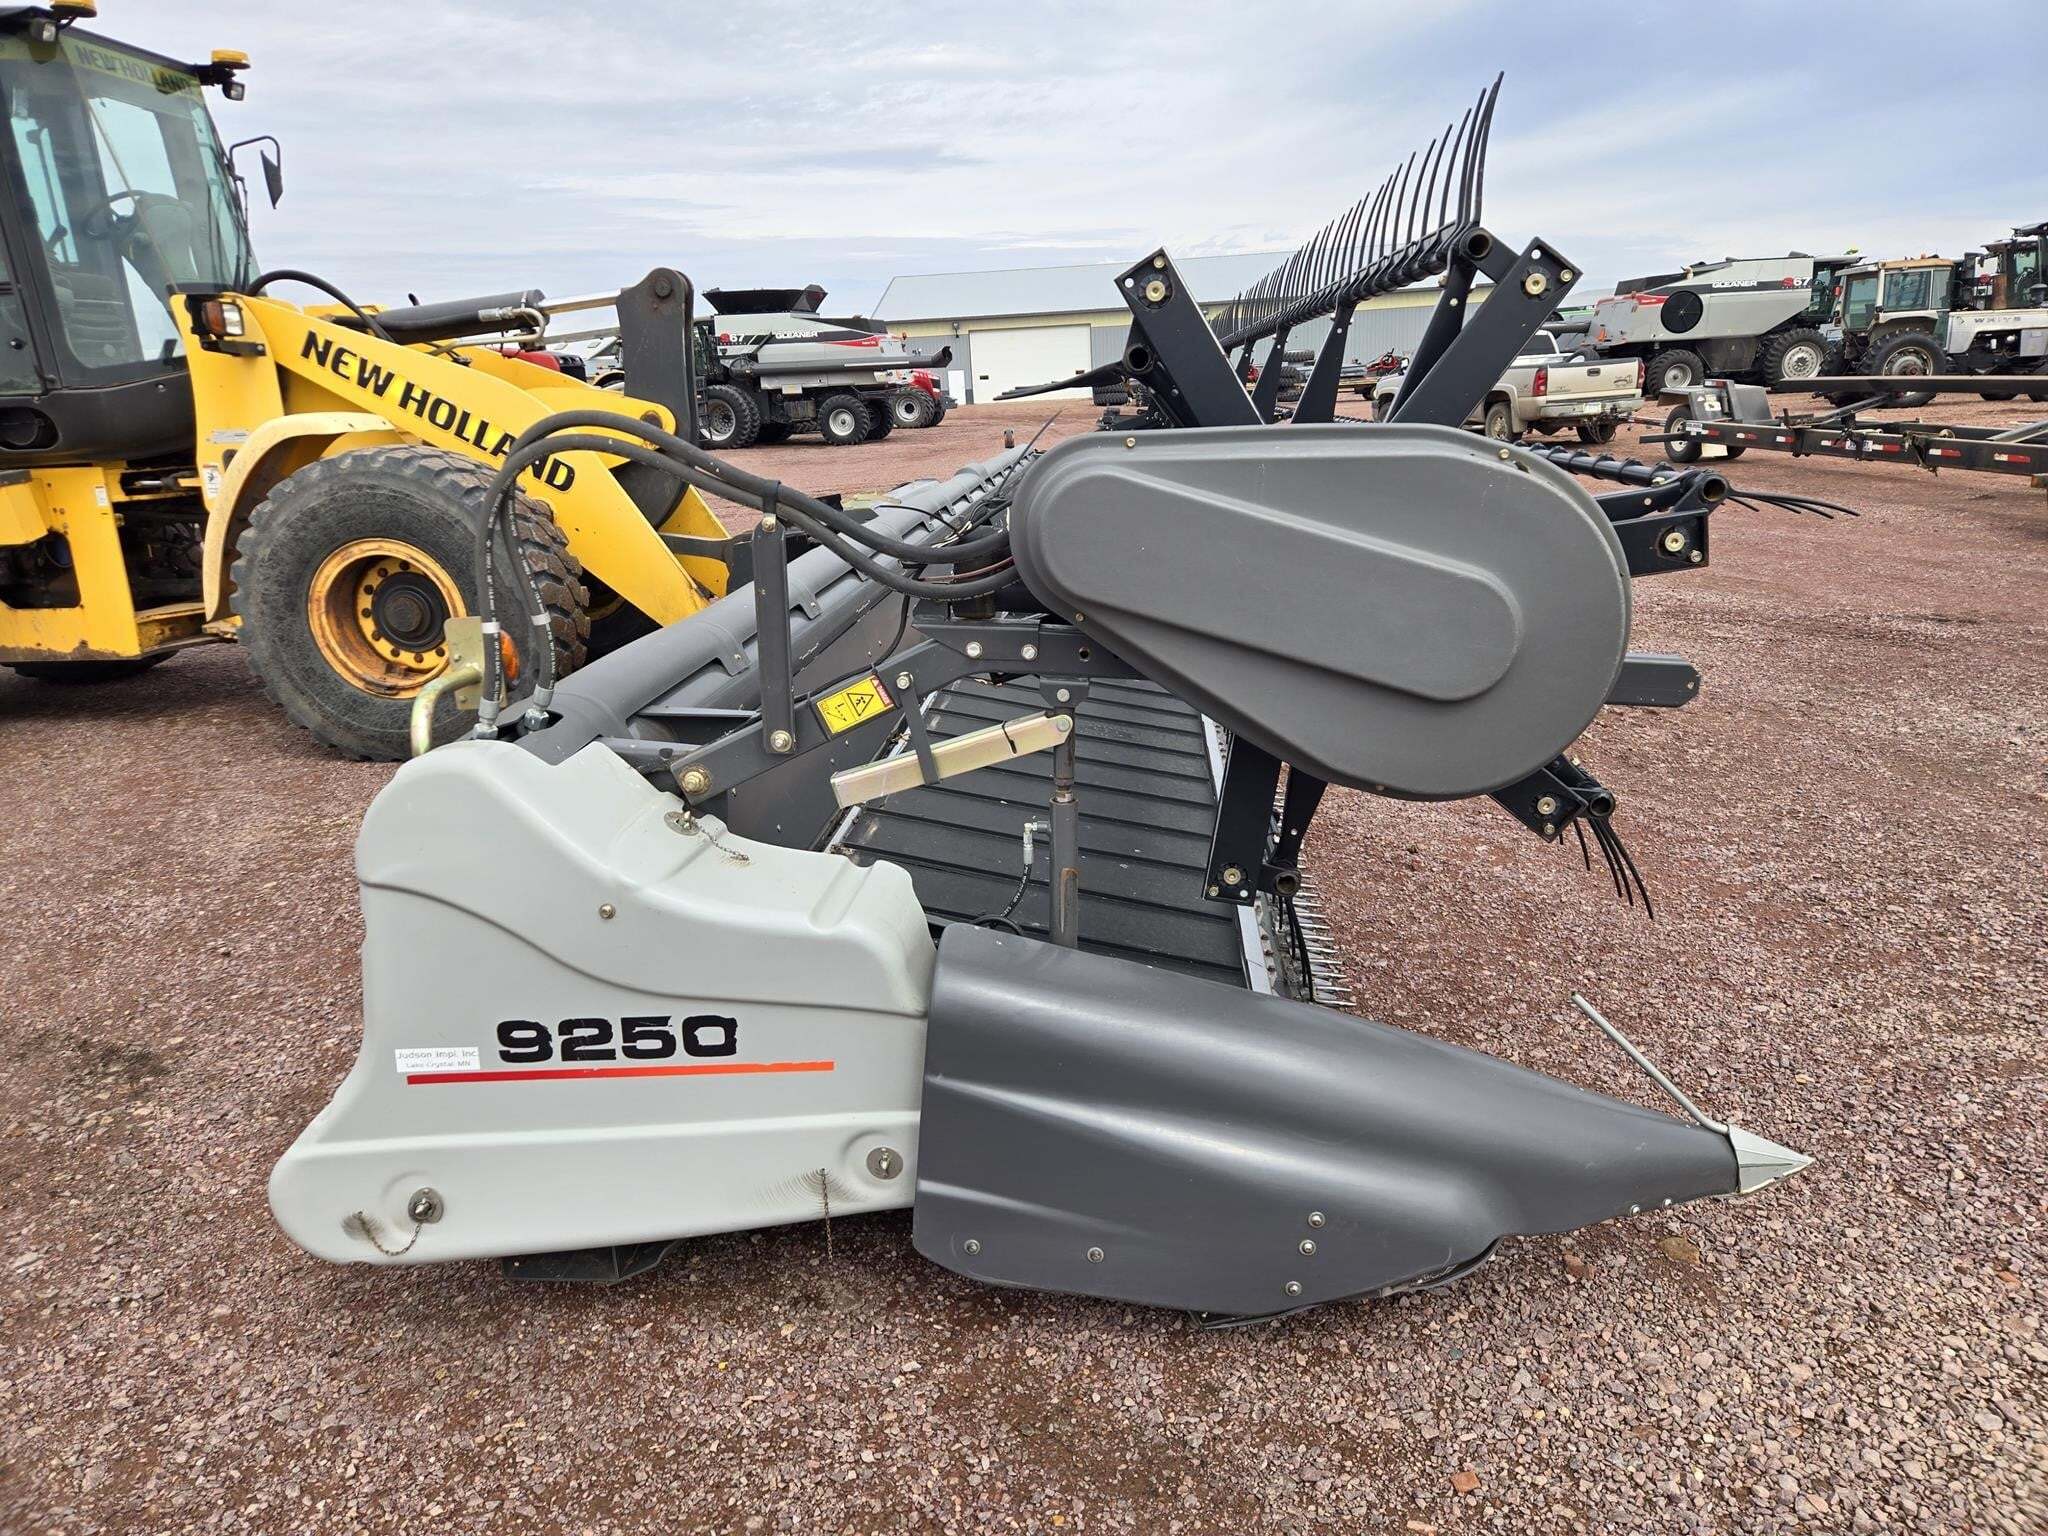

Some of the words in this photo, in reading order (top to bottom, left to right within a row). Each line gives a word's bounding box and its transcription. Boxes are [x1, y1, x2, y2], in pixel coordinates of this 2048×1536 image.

[1711, 279, 1758, 288] GLEANER
[775, 330, 819, 339] GLEANER
[300, 330, 395, 397] NEW
[496, 1015, 737, 1063] 9250
[398, 1051, 433, 1060] Judson
